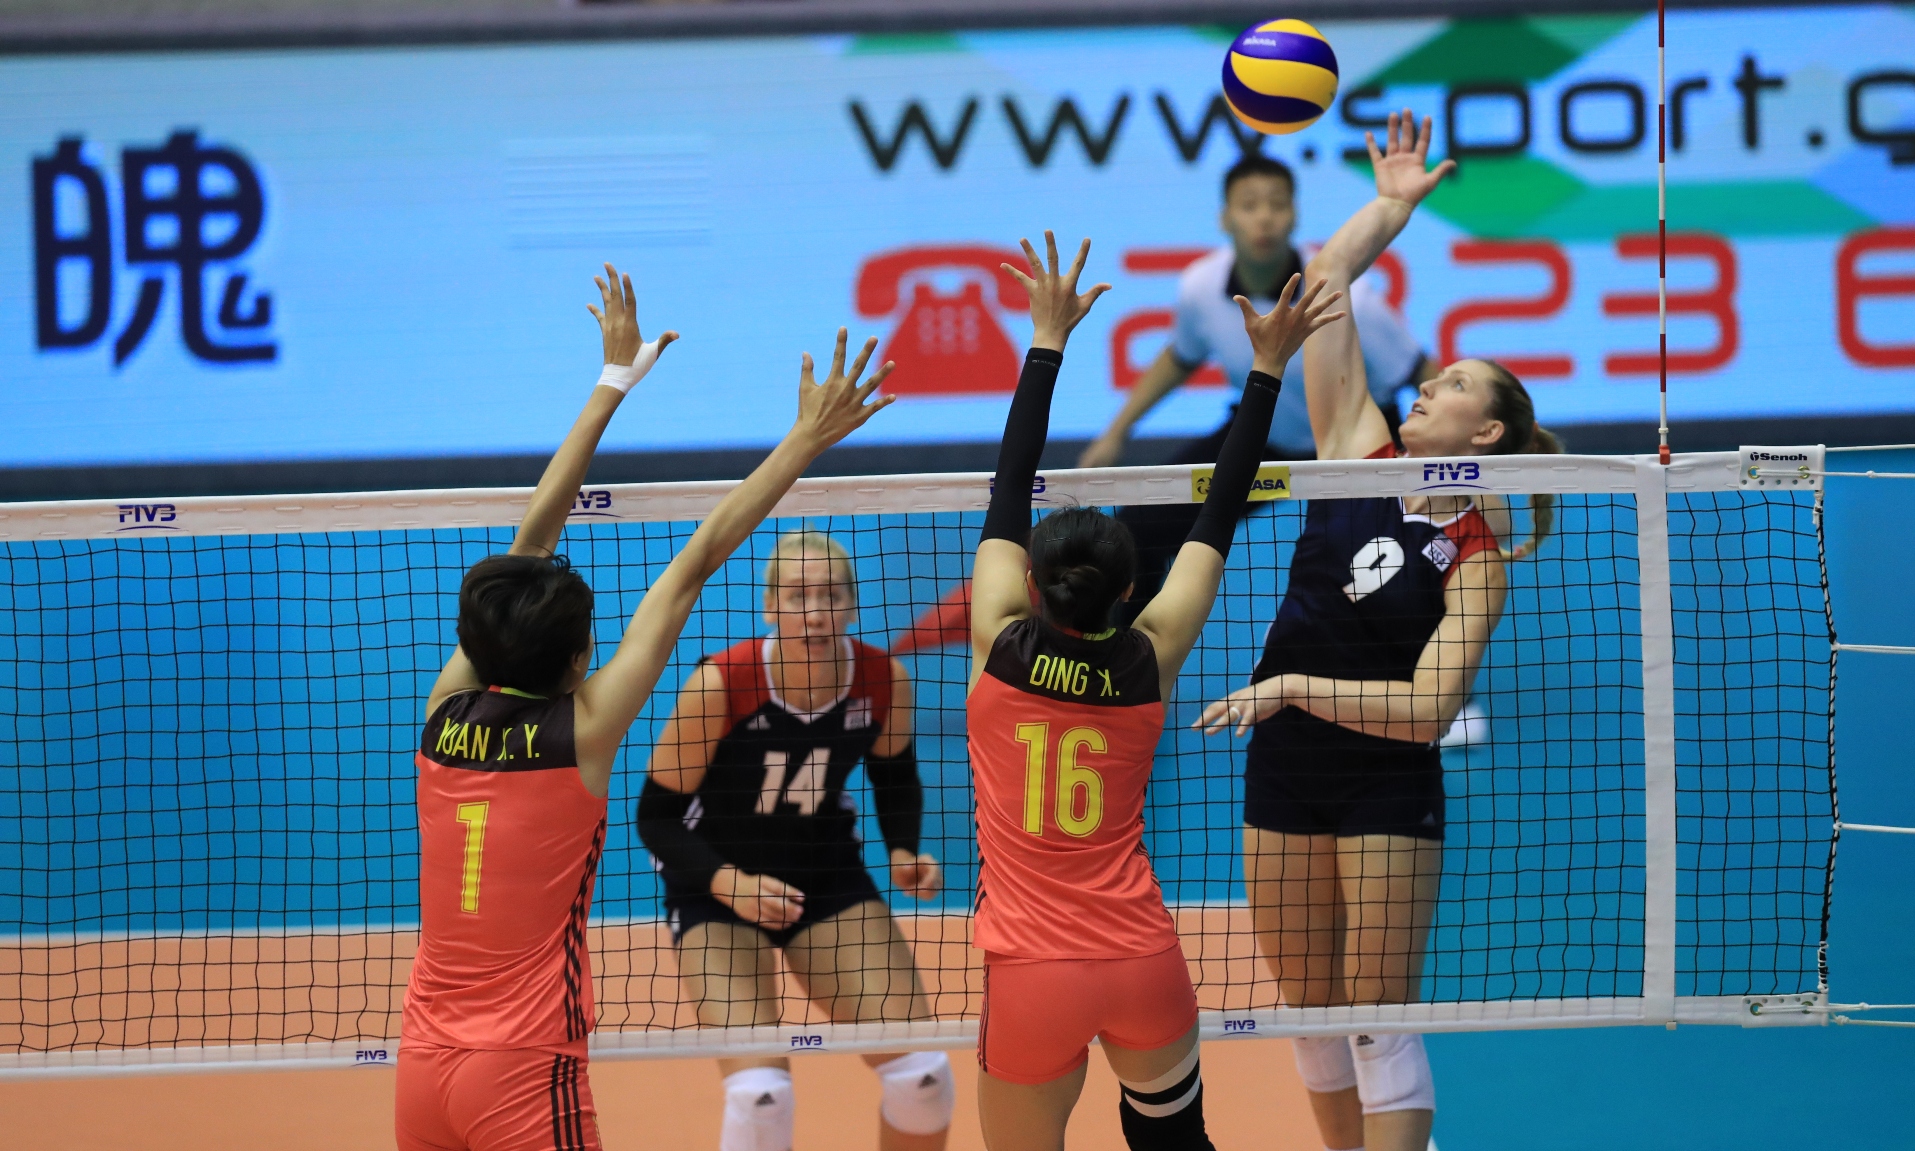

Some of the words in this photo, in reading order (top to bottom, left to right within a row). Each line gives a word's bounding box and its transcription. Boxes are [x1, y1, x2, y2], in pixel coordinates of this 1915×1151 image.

[1424, 462, 1480, 481] FIVB
[1760, 453, 1808, 461] Senoh
[119, 504, 176, 522] FIVB
[1342, 536, 1405, 603] 9
[1029, 654, 1090, 696] DING
[435, 717, 491, 762] YUAN
[524, 723, 540, 759] Y.
[753, 747, 831, 815] 14
[1015, 721, 1108, 838] 16
[456, 801, 490, 914] 1
[1224, 1019, 1256, 1031] FIVB
[356, 1050, 388, 1061] FIVB
[791, 1035, 823, 1047] FIVB
